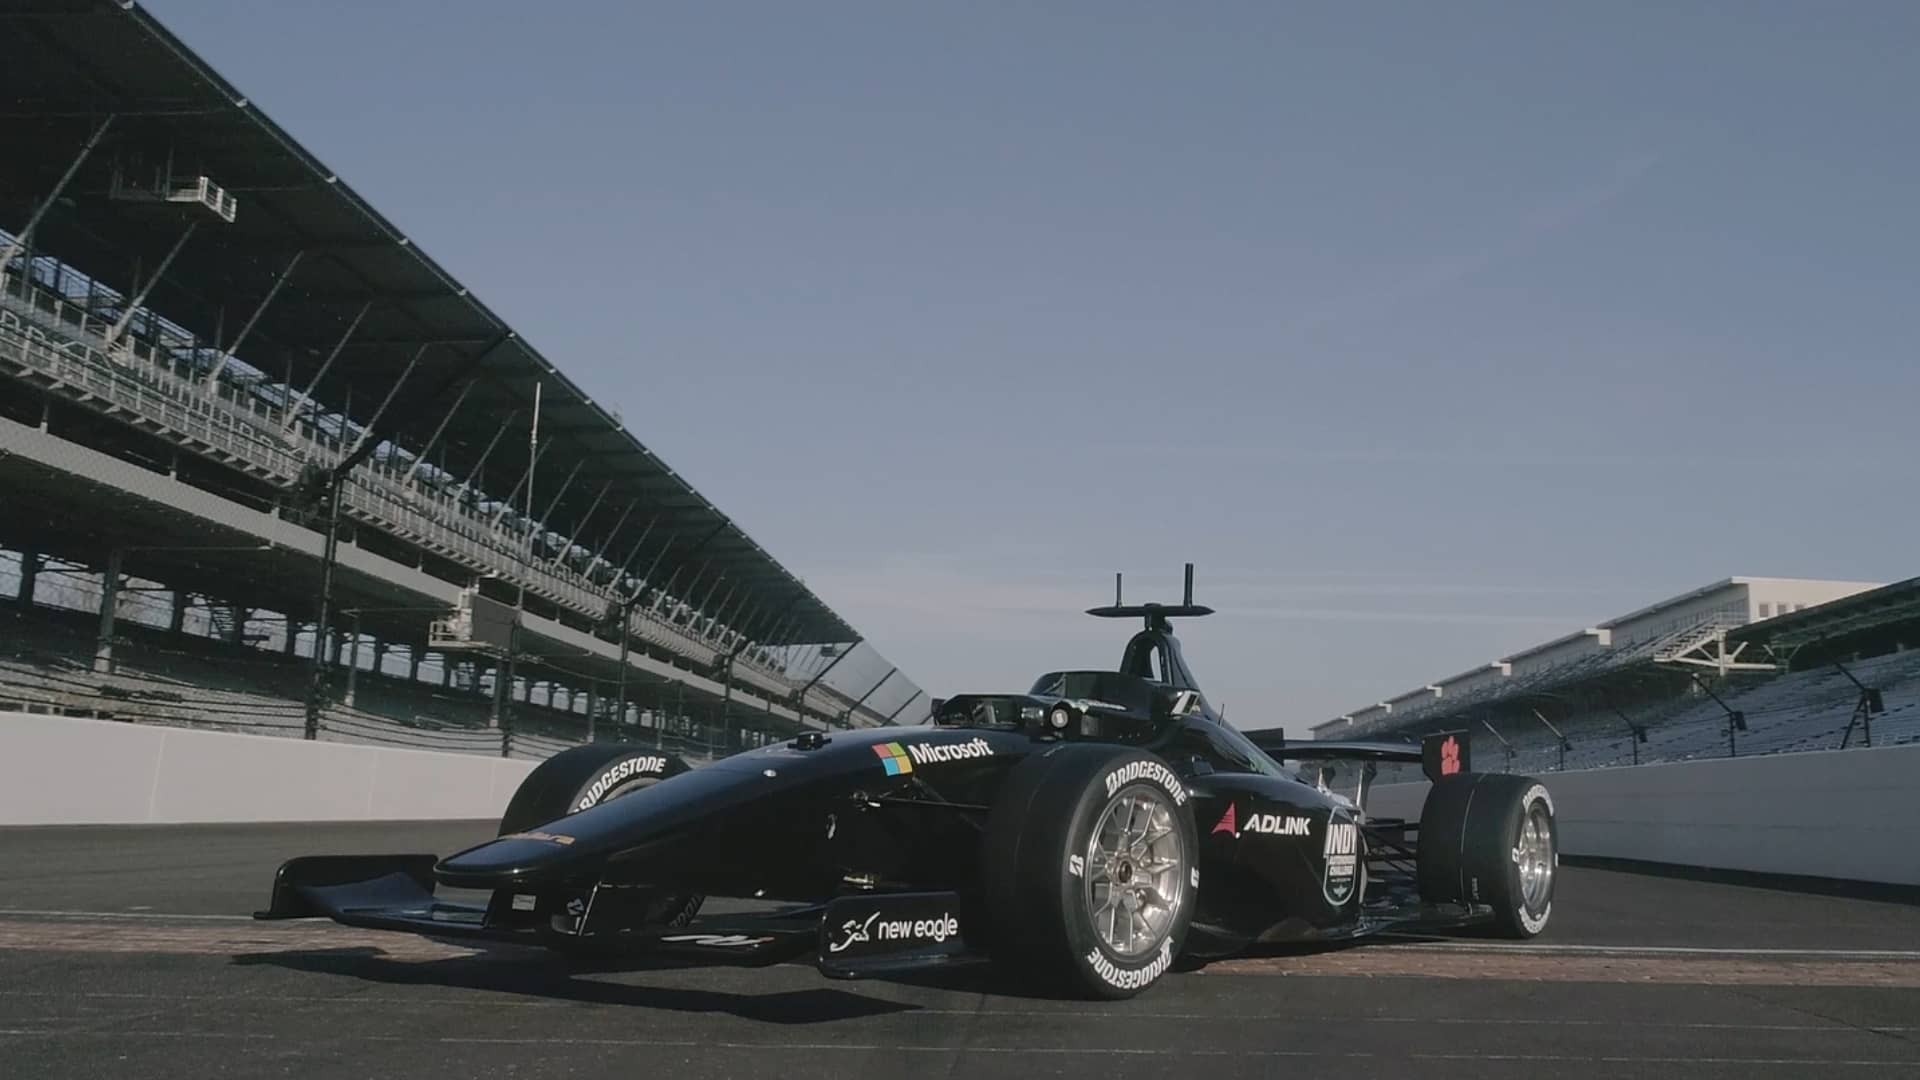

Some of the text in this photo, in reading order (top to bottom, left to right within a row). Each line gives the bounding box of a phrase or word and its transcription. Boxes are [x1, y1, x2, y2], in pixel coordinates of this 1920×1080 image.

[908, 737, 994, 764] Microsoft
[574, 756, 666, 812] RIDGESTONE
[1105, 761, 1188, 806] BRIDGESTONE
[1242, 814, 1311, 836] ADLINK
[878, 912, 958, 942] new eagle
[1087, 936, 1174, 989] BRIDGESTONE
